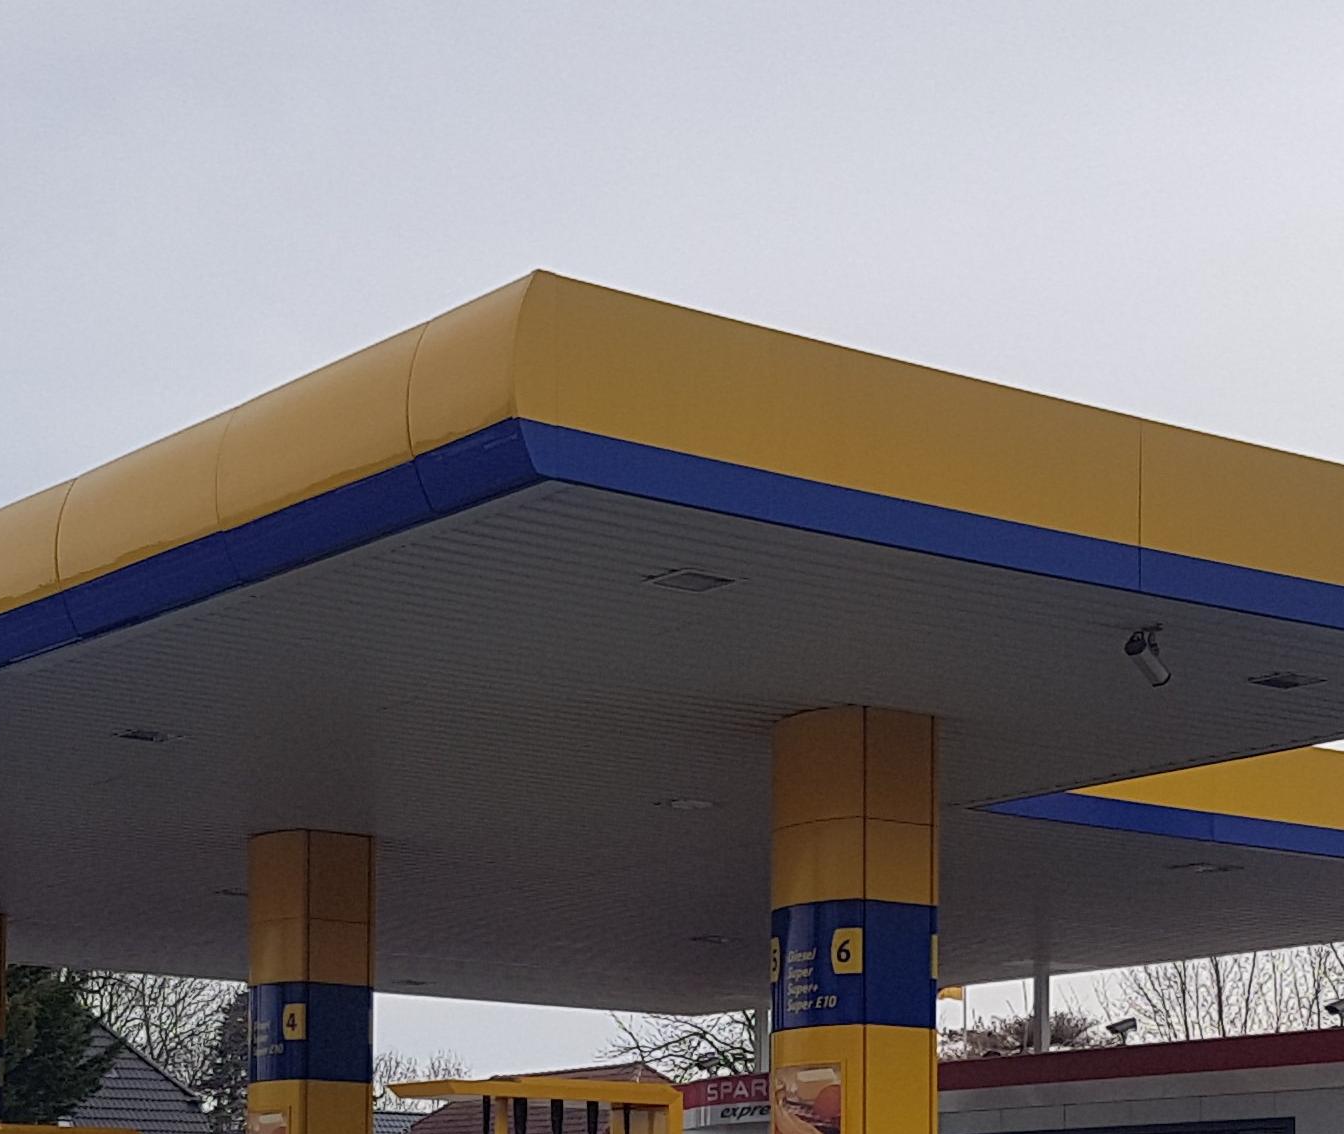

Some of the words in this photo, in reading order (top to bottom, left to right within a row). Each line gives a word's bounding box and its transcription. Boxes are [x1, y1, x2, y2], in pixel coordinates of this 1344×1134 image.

[787, 947, 817, 963] Diesel
[836, 939, 851, 963] 6
[787, 966, 814, 981] Super
[787, 982, 819, 997] Super+
[786, 999, 813, 1014] Super
[814, 995, 838, 1009] E10
[286, 1012, 298, 1031] 4
[706, 1078, 768, 1102] SPAR
